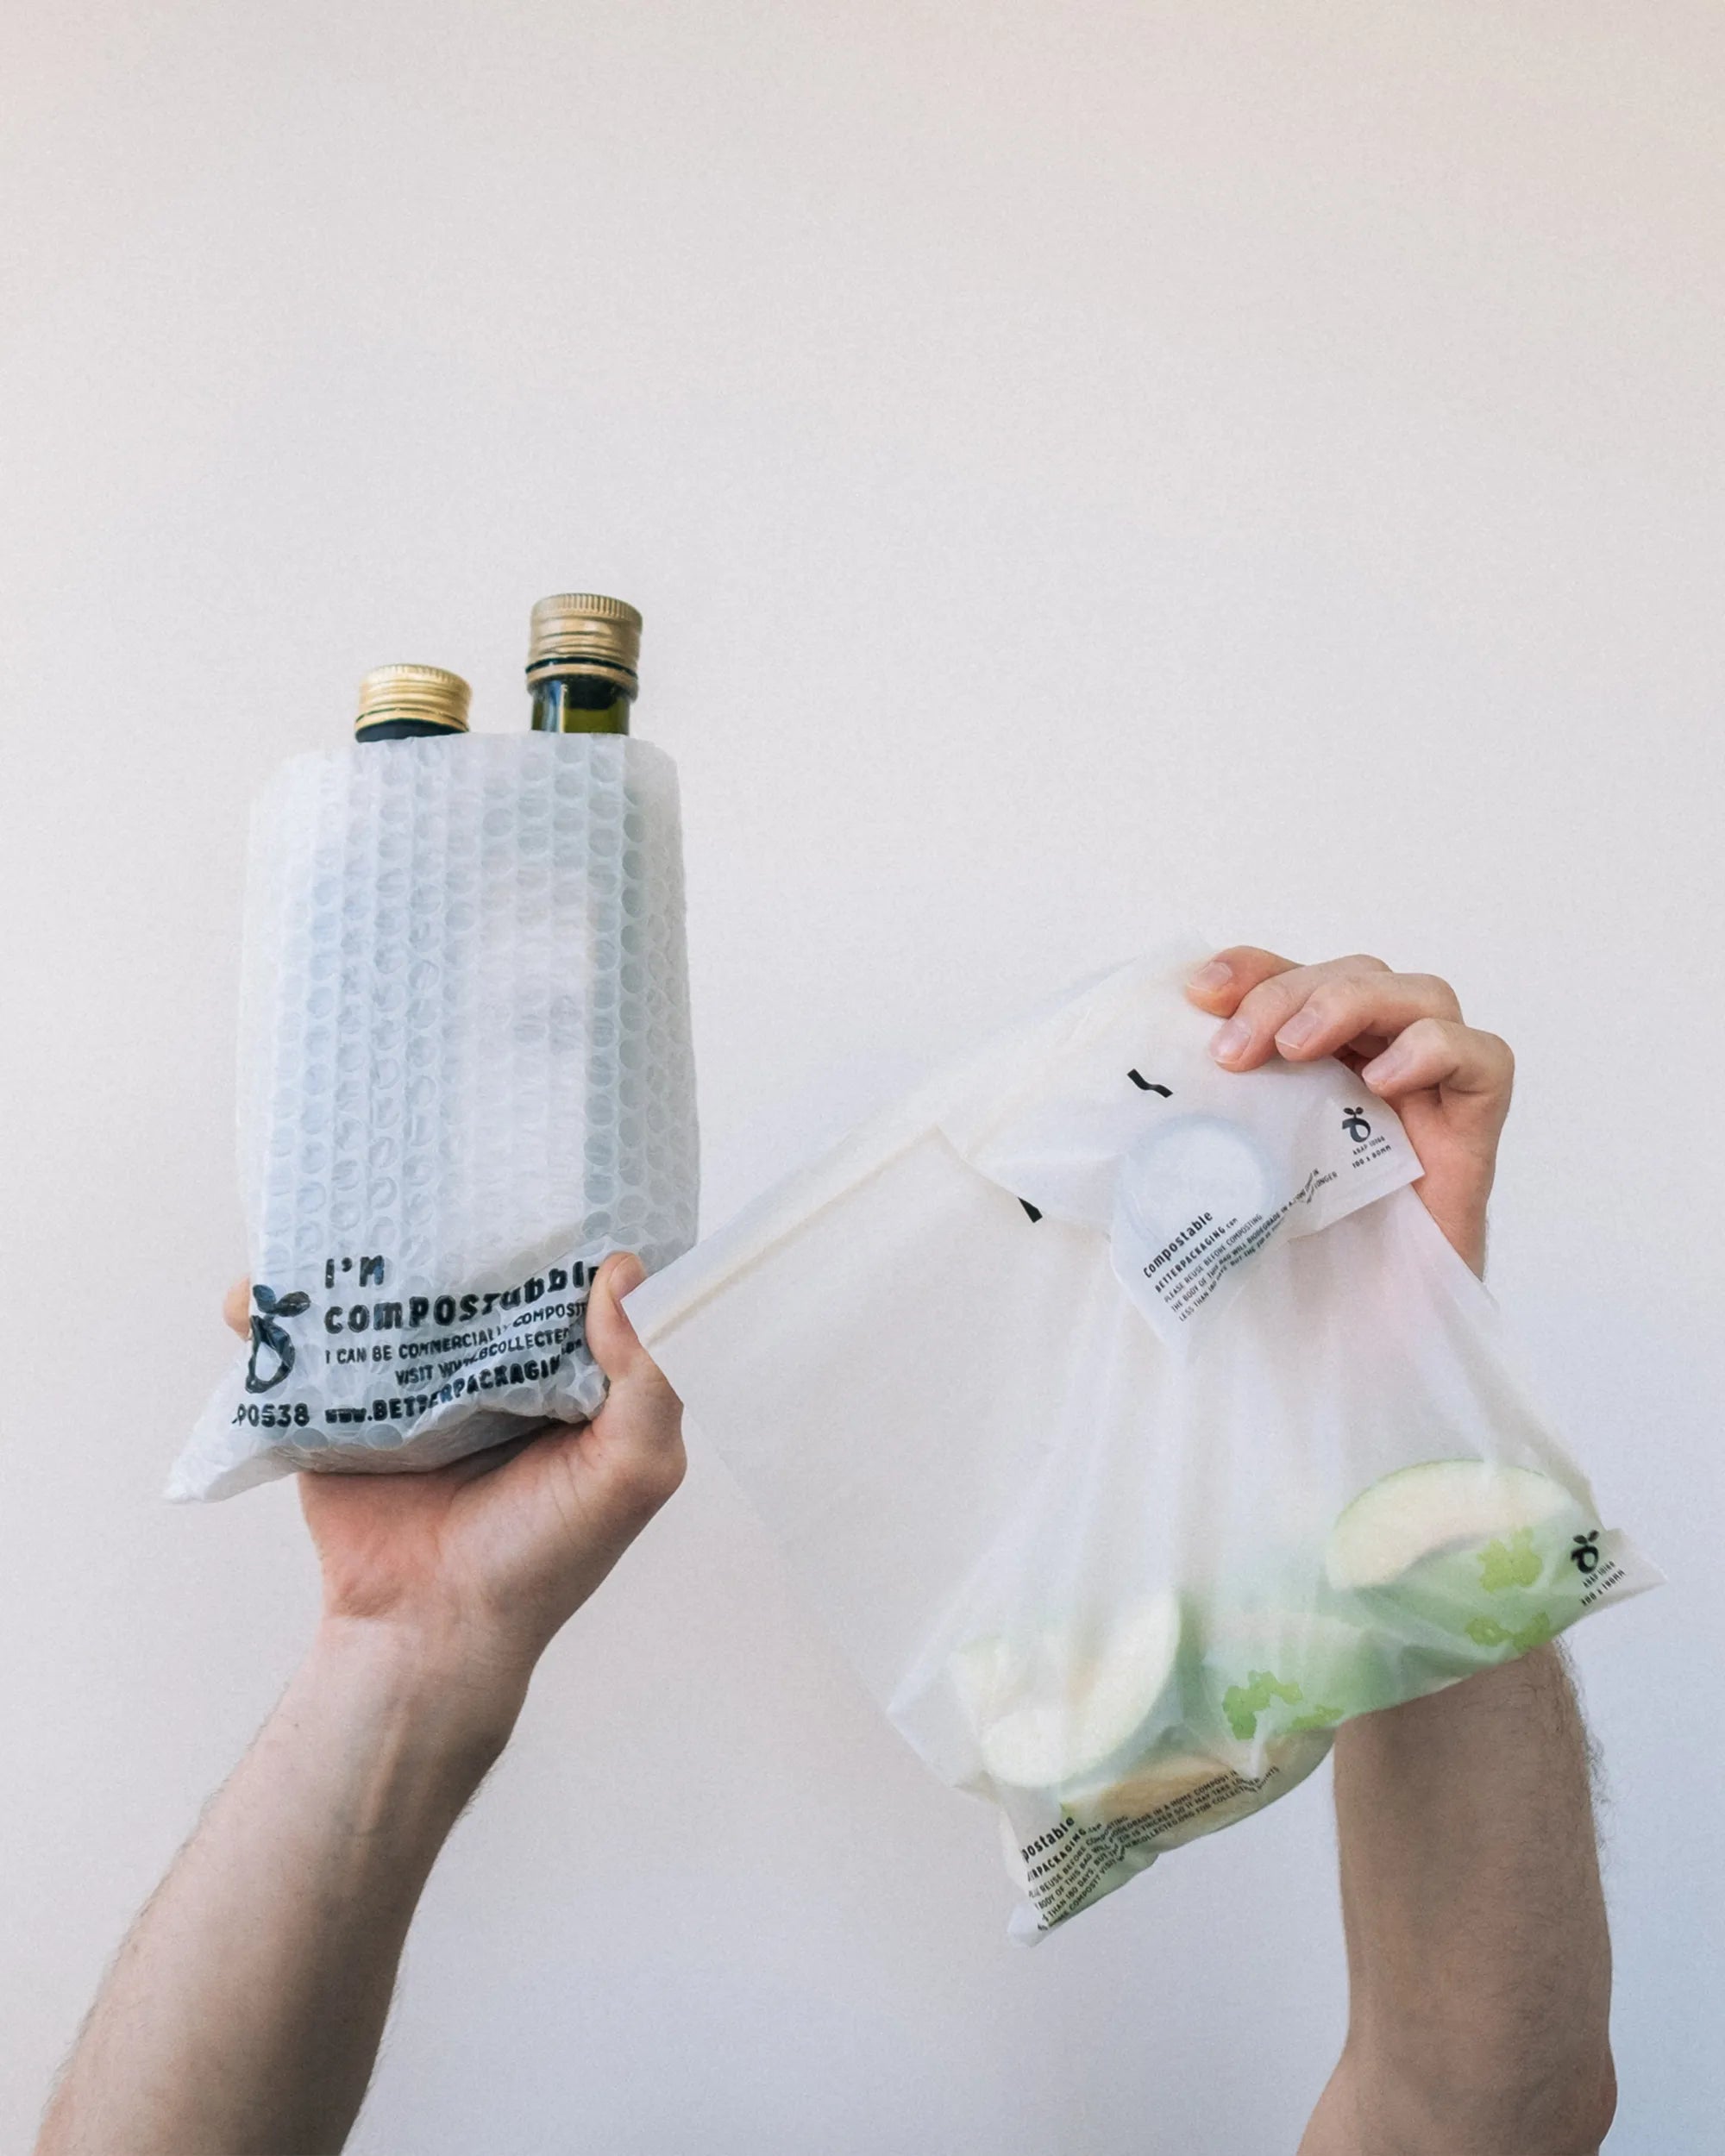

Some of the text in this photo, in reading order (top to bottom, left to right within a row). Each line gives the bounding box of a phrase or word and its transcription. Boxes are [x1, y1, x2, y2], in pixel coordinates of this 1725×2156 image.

[1143, 1212, 1213, 1278] Compostable
[1183, 1265, 1204, 1283] REUSE
[1226, 1213, 1263, 1246] COMPOSTING
[324, 1255, 385, 1288] I'M
[1182, 1285, 1199, 1301] BODY
[1194, 1290, 1209, 1307] THAN
[336, 1349, 367, 1364] CAN
[372, 1345, 392, 1362] BE
[395, 1364, 434, 1386] VISIT
[1038, 1894, 1055, 1909] BODY
[1055, 1885, 1064, 1896] OF
[1064, 1869, 1081, 1885] THIS
[1079, 1852, 1092, 1870] BAG
[1194, 1774, 1229, 1796] COMPOST
[1039, 1873, 1063, 1893] REUSE
[1063, 1846, 1086, 1875] BEFORE
[1047, 1899, 1066, 1917] THAN
[1094, 1852, 1108, 1866] BUT
